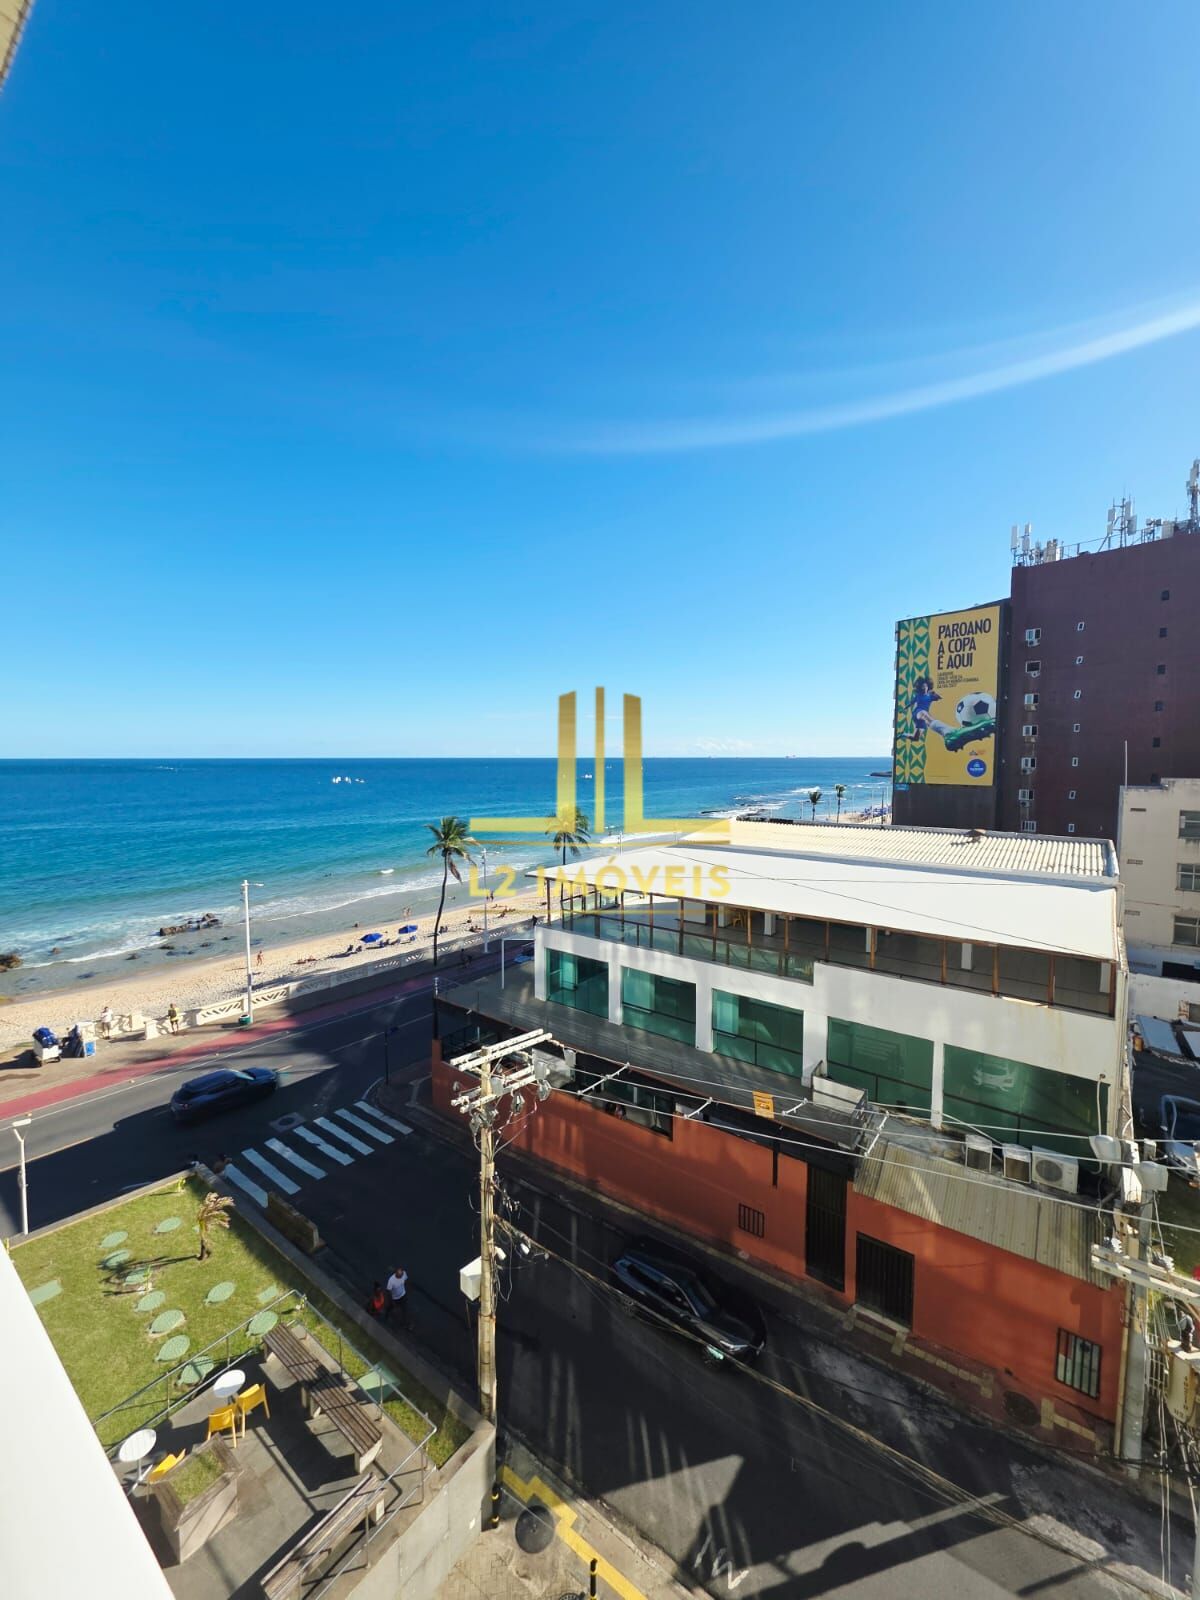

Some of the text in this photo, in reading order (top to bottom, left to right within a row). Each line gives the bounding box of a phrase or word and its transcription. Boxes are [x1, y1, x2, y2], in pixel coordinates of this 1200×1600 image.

[938, 618, 991, 639] PAROANO
[938, 637, 976, 655] A COPA
[947, 653, 973, 670] AQUI
